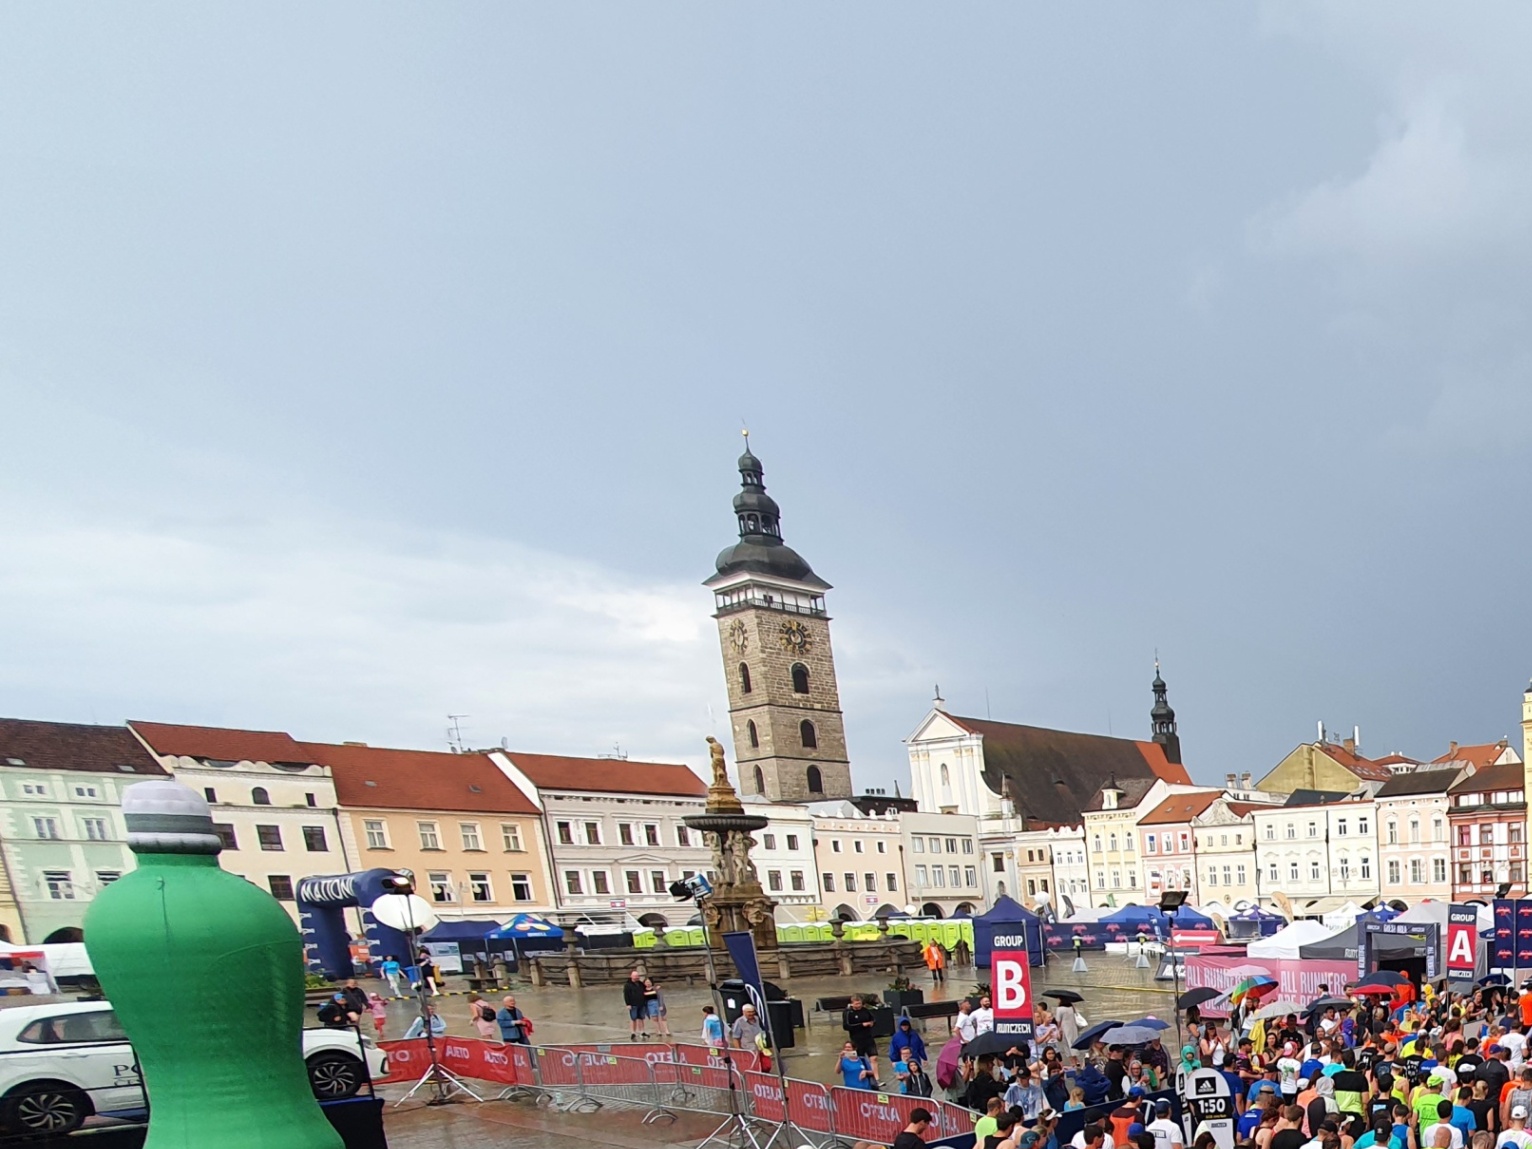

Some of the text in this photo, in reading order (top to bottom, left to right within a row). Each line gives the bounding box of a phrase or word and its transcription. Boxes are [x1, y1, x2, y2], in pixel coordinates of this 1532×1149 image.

[1451, 913, 1475, 922] GROUP
[994, 935, 1023, 947] GROUP
[1449, 930, 1473, 963] A
[996, 960, 1026, 1009] B
[1187, 964, 1202, 987] ALL
[1280, 970, 1347, 996] ALL RUNNERS
[1198, 1098, 1226, 1113] 1:50
